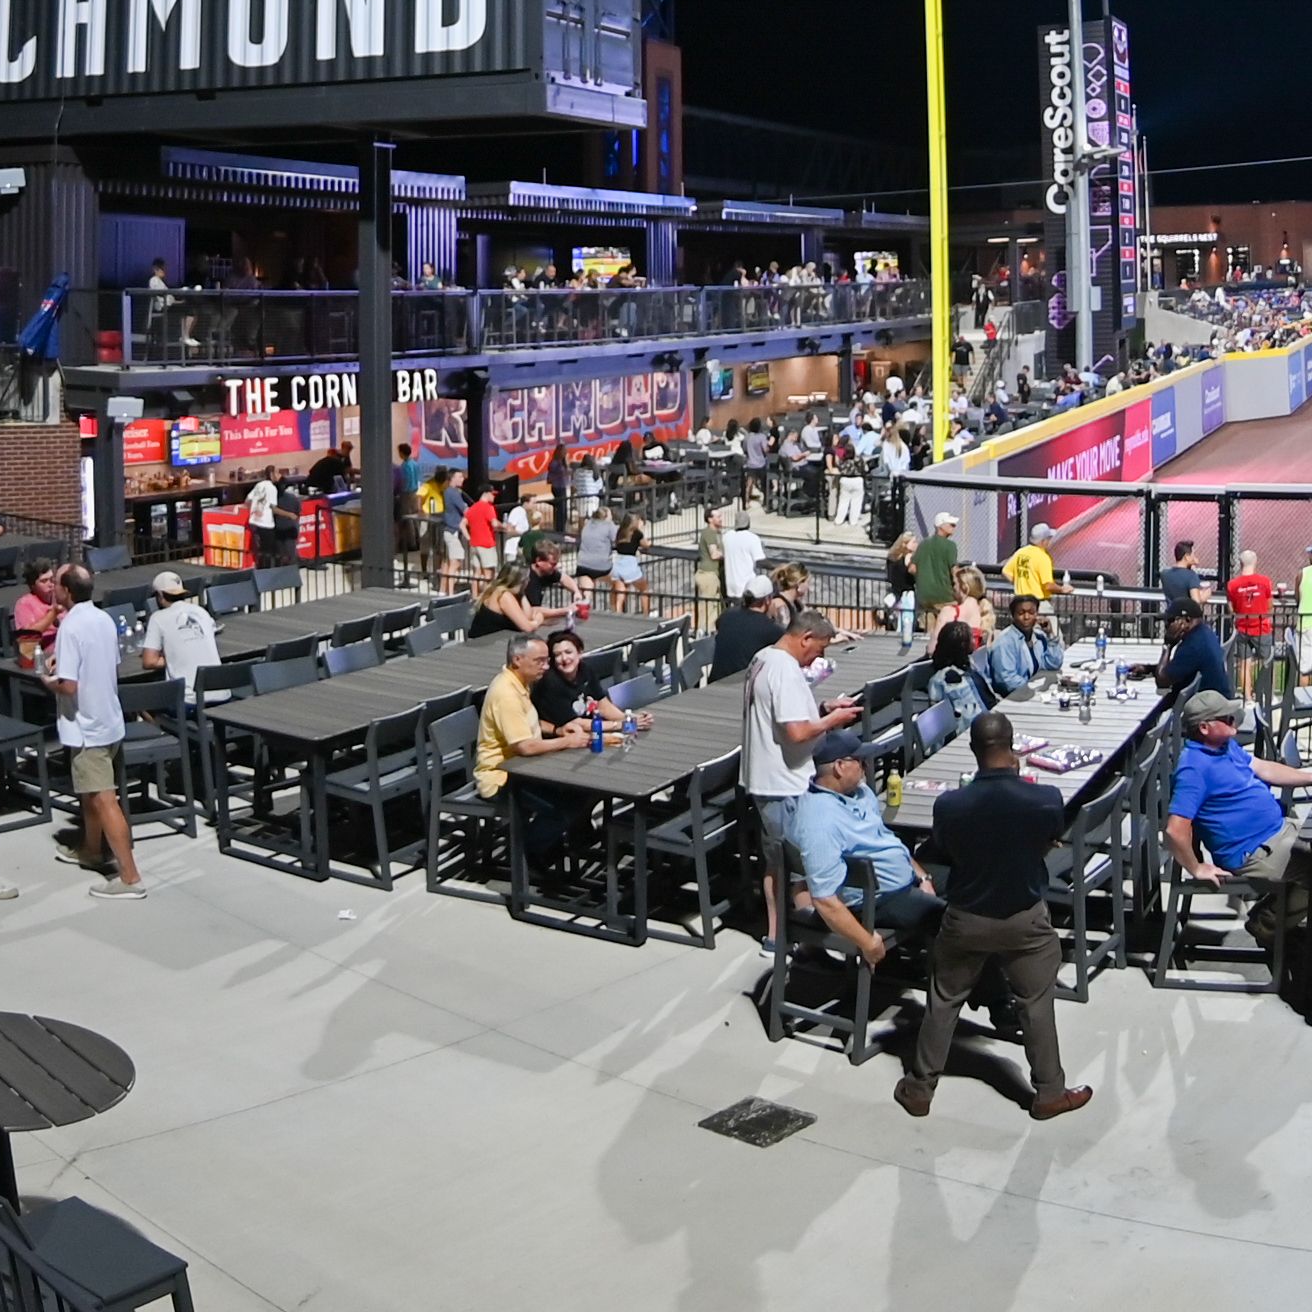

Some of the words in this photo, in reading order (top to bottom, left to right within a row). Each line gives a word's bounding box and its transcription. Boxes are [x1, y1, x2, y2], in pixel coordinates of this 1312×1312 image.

[1043, 28, 1070, 214] CareScout
[224, 377, 281, 417] THE
[291, 373, 358, 411] CORN
[396, 368, 438, 403] BAR
[421, 371, 682, 448] RCHMOND
[223, 429, 242, 441] This
[265, 426, 278, 437] For
[278, 424, 293, 436] You
[1047, 458, 1074, 491] MAKE
[1075, 446, 1099, 481] YOUR
[1099, 434, 1121, 473] MOVE
